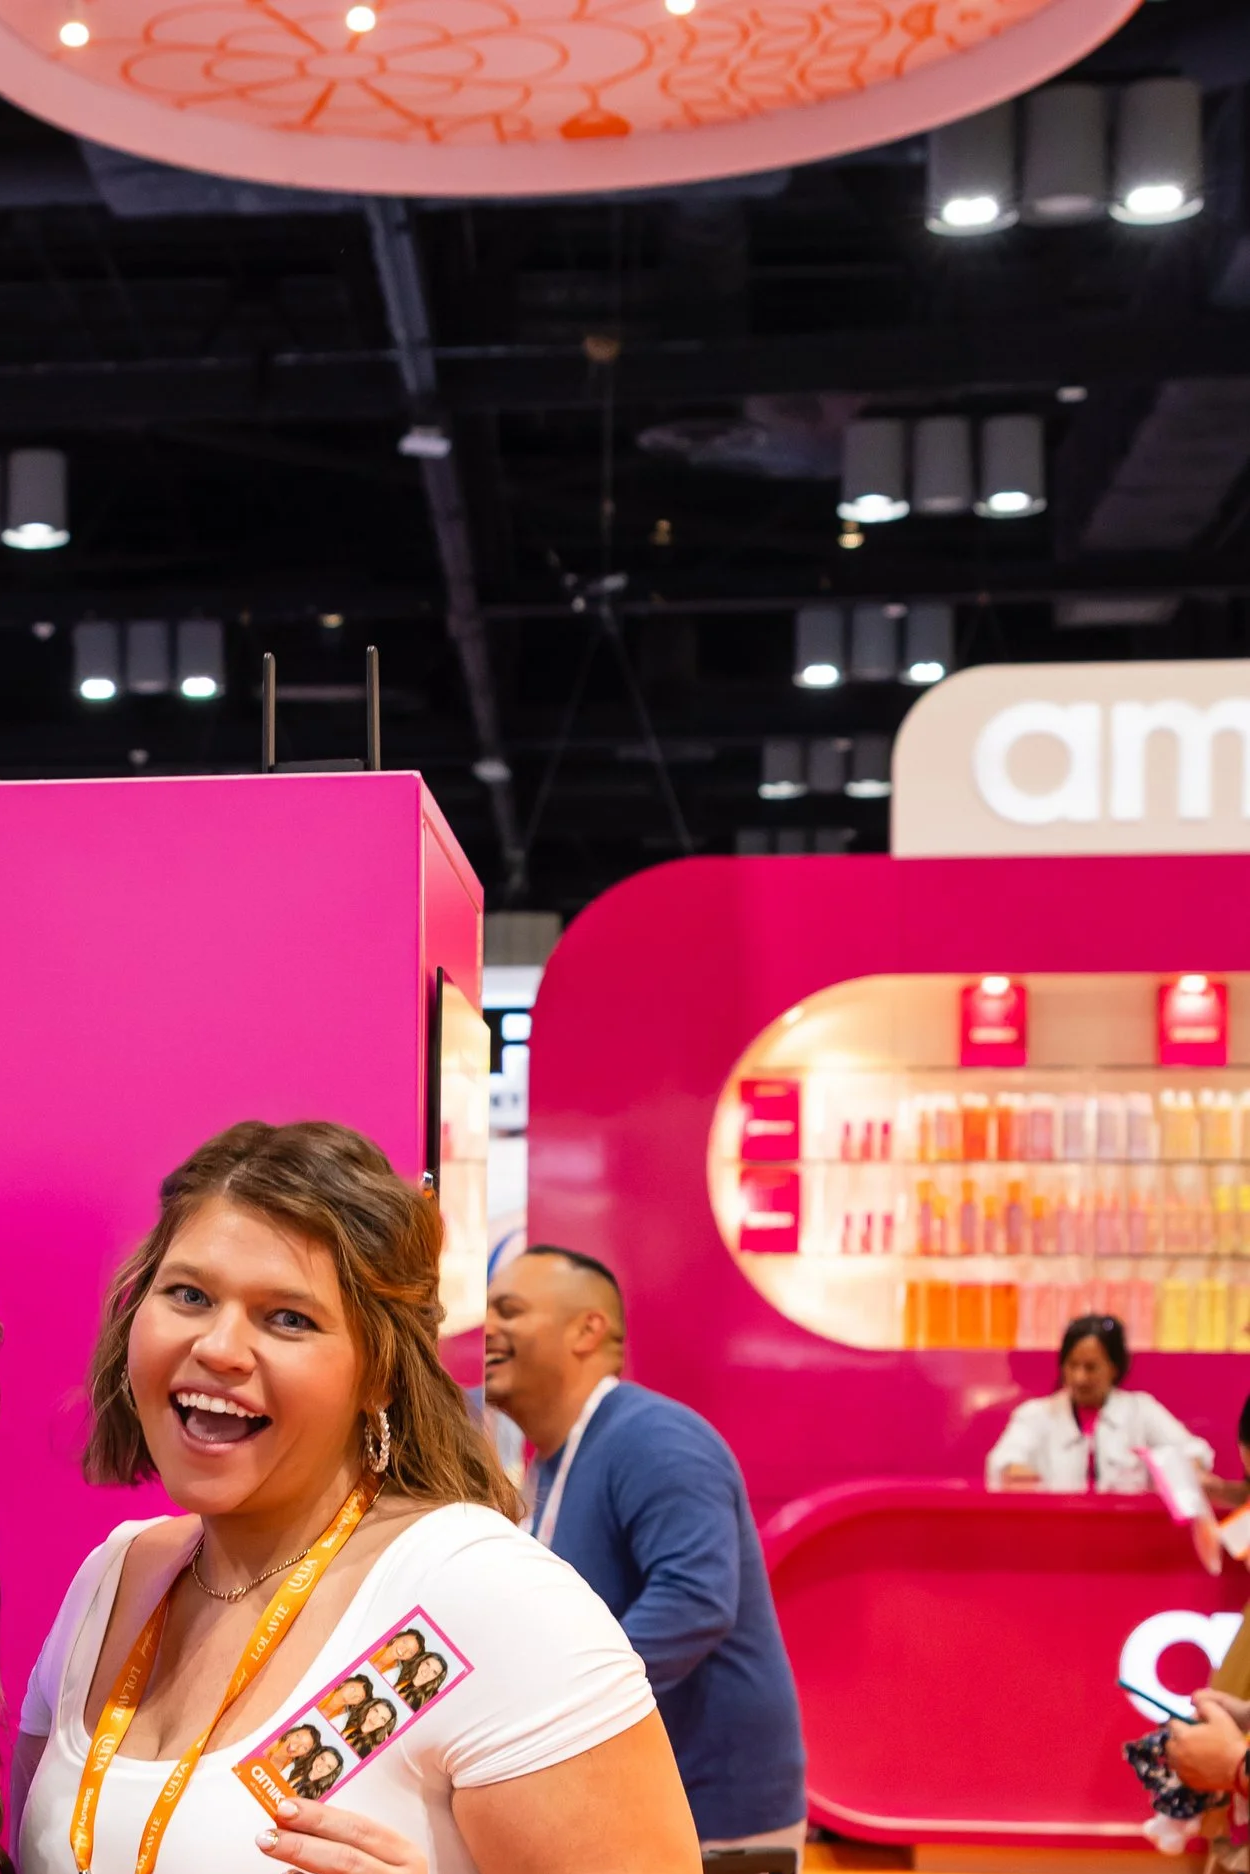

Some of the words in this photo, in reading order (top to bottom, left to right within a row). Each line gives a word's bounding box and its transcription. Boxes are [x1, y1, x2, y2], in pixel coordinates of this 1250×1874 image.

[250, 1602, 291, 1661] LOLAVIE
[162, 1762, 190, 1802] ULTA
[251, 1764, 286, 1804] amik
